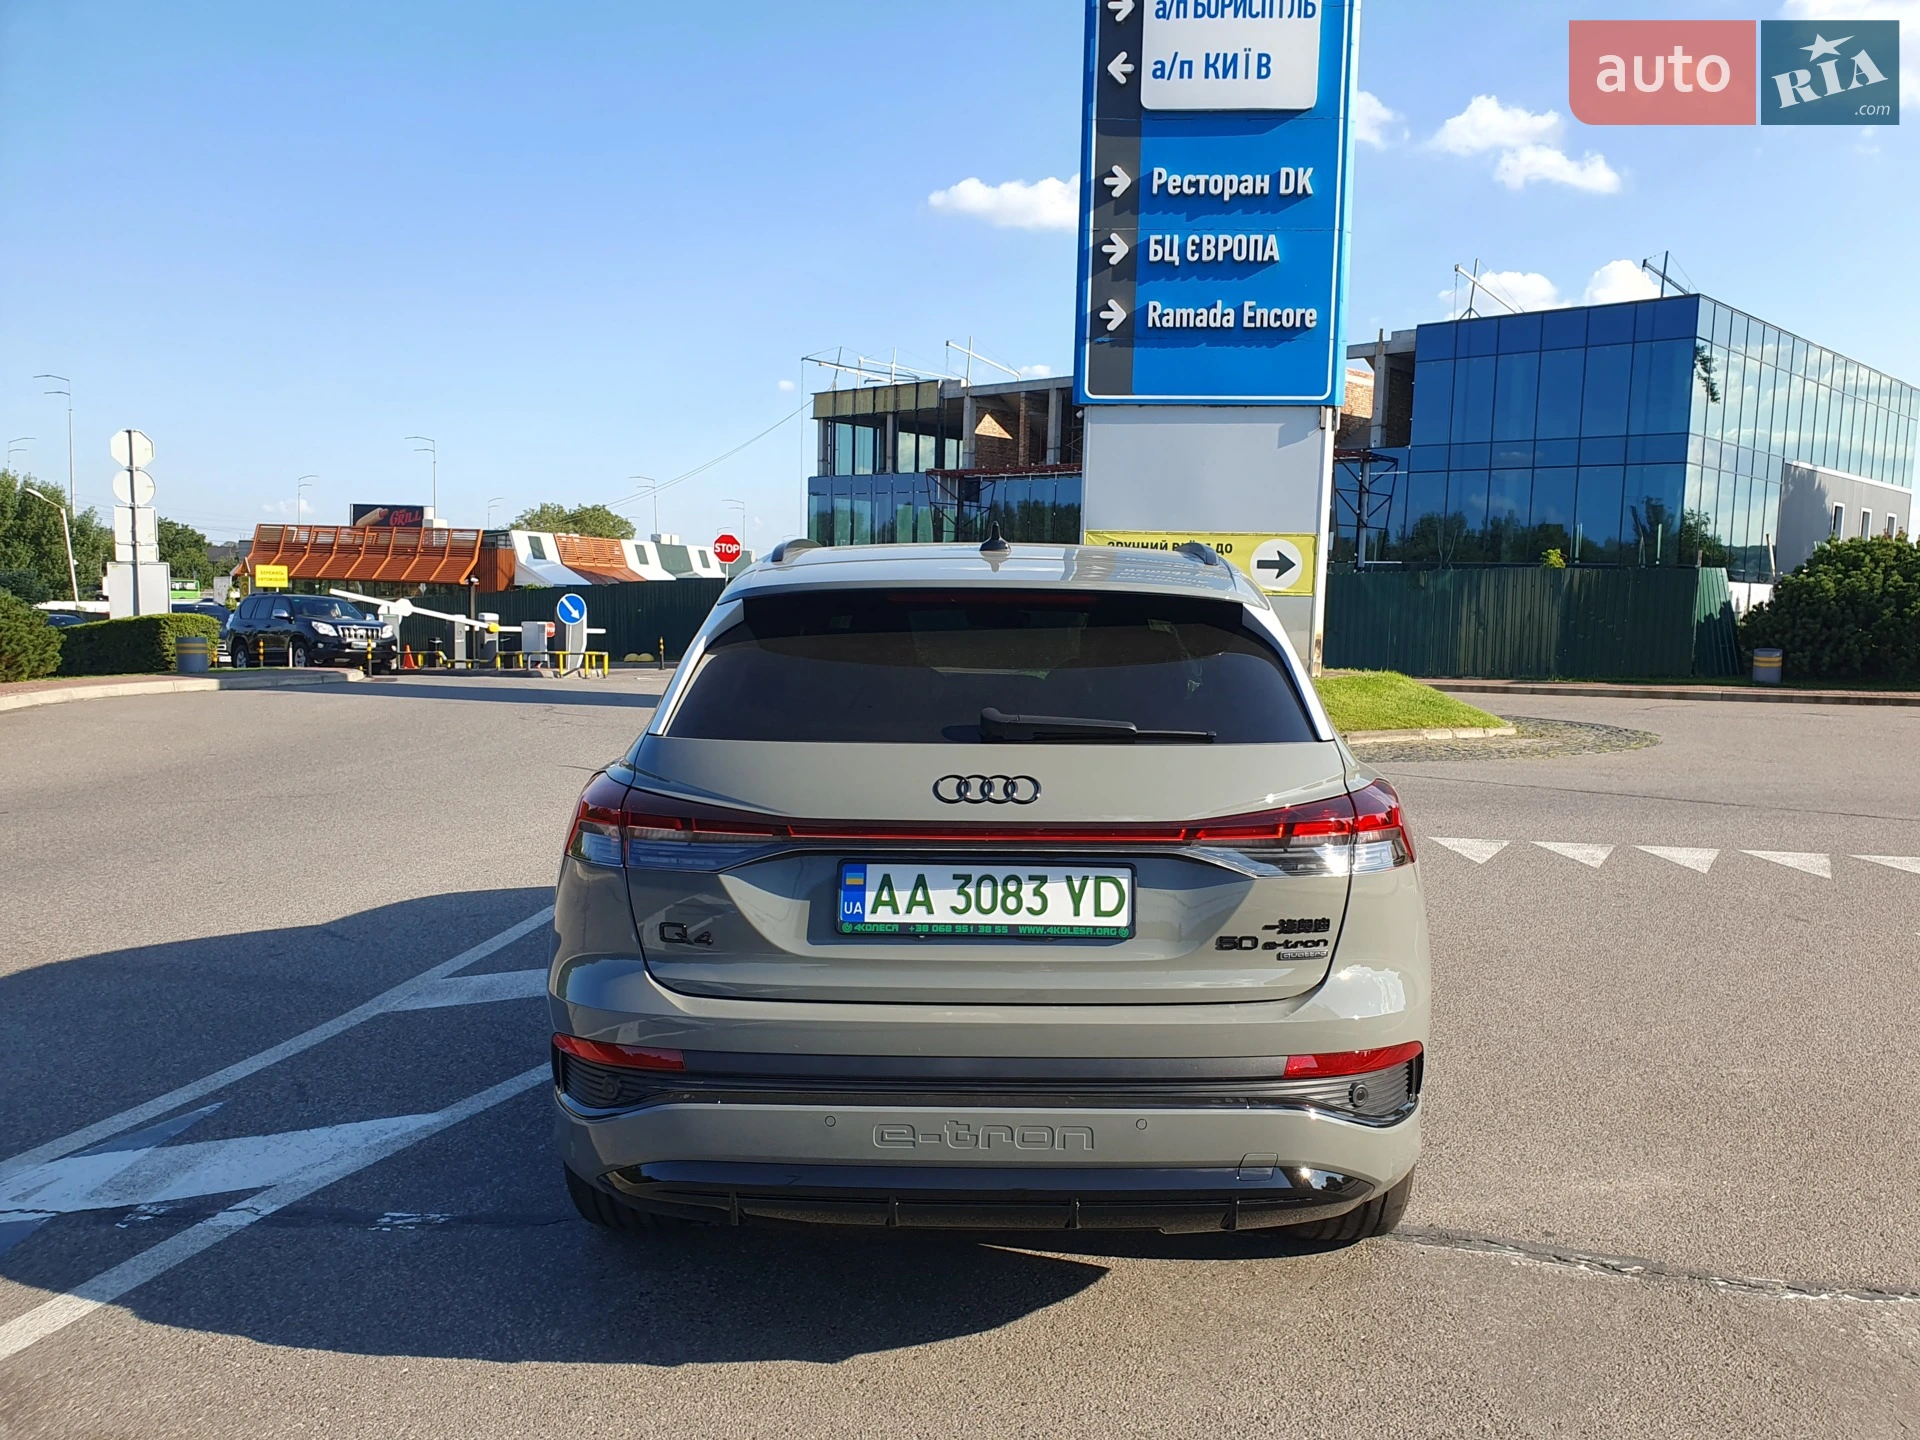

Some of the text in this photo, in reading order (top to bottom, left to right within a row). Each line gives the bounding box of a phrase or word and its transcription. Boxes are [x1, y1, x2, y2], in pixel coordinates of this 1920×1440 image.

[1154, 0, 1188, 20] а/п
[1151, 47, 1273, 80] а/п КИЇВ
[1151, 166, 1314, 202] Ресторан DK
[1148, 234, 1280, 266] БЦ ЄВРОПА
[1147, 300, 1318, 329] Ramada Encore
[714, 543, 740, 554] STOP
[1215, 543, 1234, 555] ДО
[844, 901, 863, 915] UA
[870, 873, 1127, 918] AA 3083 YD
[659, 921, 714, 946] Q4
[908, 924, 1009, 934] +38 068 951 38 55
[1214, 935, 1329, 951] 50 e-tron
[872, 1119, 1095, 1151] e-tron
